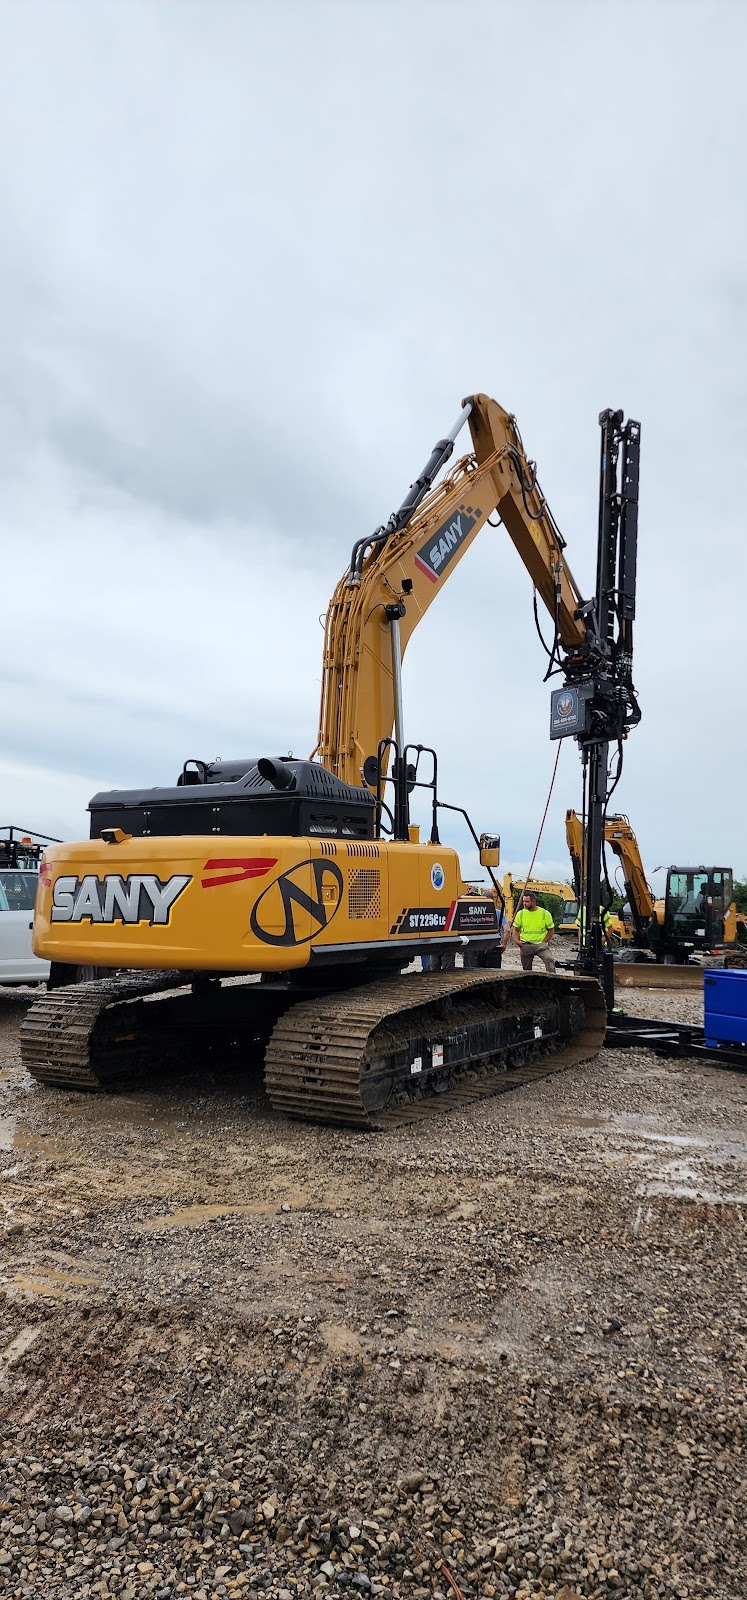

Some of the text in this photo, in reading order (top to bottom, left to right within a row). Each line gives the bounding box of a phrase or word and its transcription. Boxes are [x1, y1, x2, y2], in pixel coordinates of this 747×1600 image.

[429, 515, 463, 570] SANY
[51, 875, 193, 924] SANY
[468, 906, 487, 914] SANY
